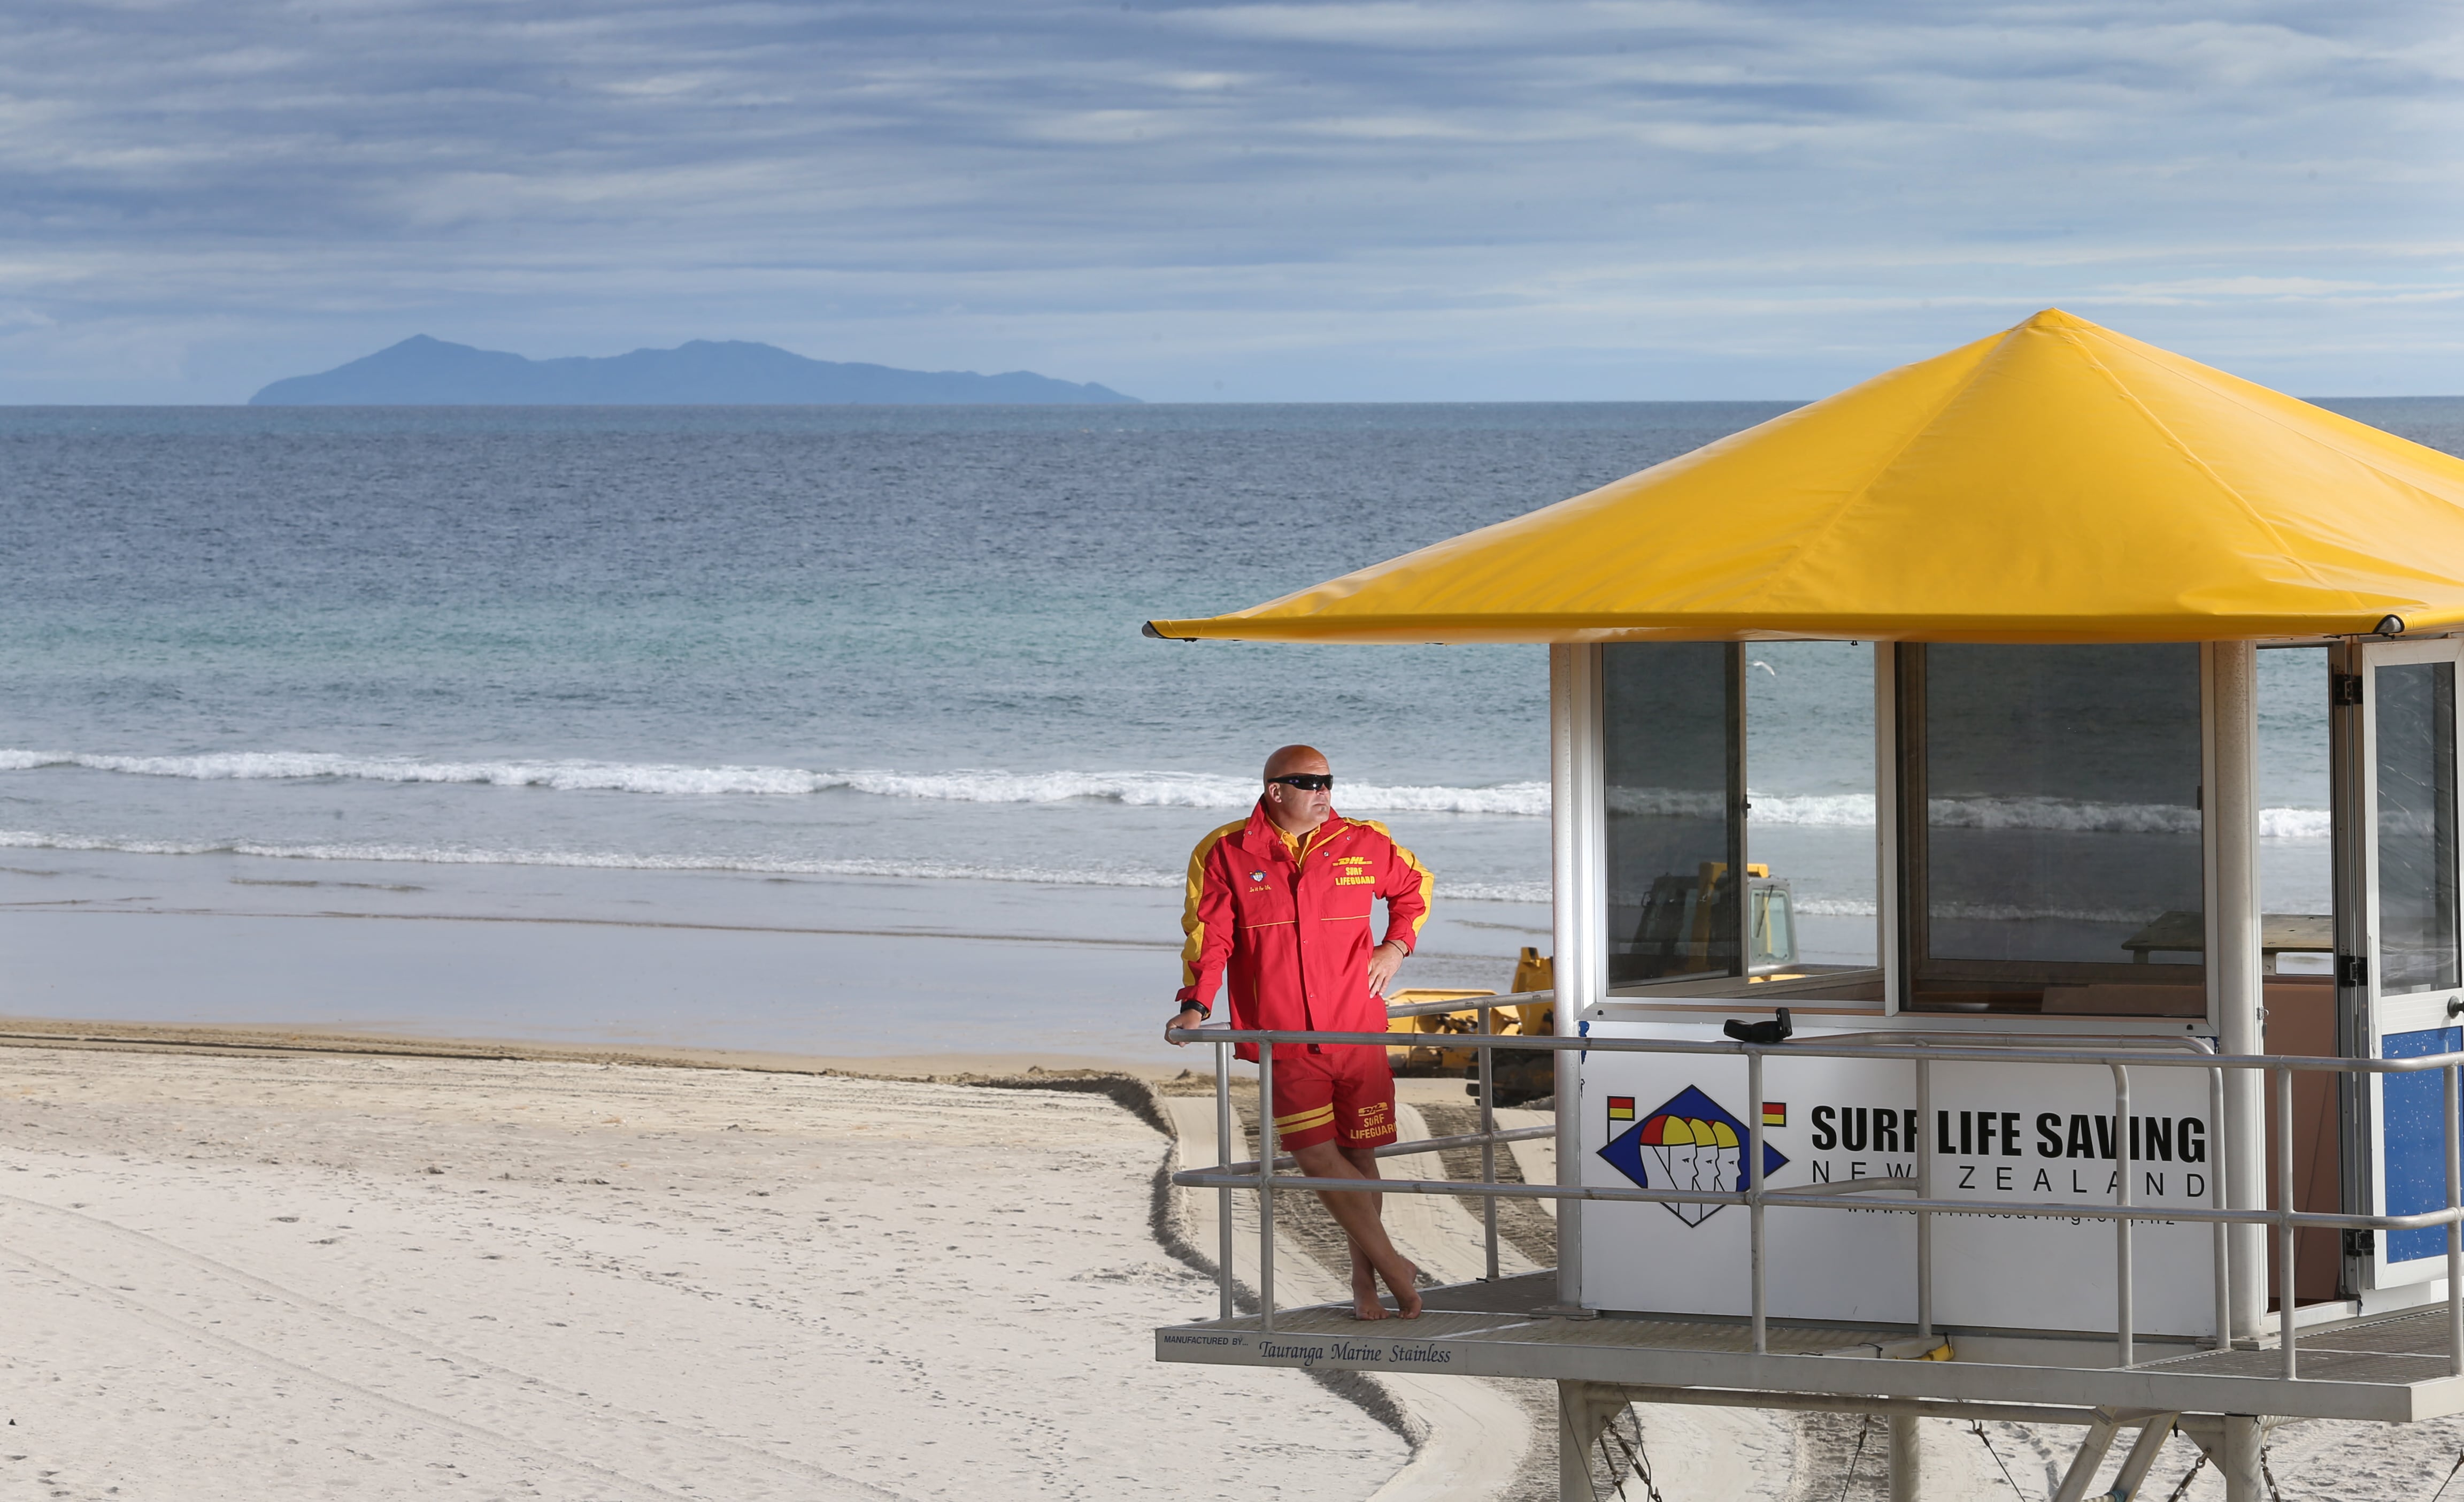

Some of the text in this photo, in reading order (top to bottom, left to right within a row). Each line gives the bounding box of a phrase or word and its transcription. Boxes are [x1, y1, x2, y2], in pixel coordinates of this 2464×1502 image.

[1337, 856, 1367, 865] DHL
[1345, 867, 1363, 876] SURF
[1335, 876, 1375, 886] LIFEGUARD
[1364, 1114, 1384, 1128] SURF
[1811, 1105, 2206, 1163] SURF LIFE SAVING
[1164, 1335, 1229, 1346] MANUFACTURED
[1259, 1340, 1451, 1367] Tauranga Marine Stainless
